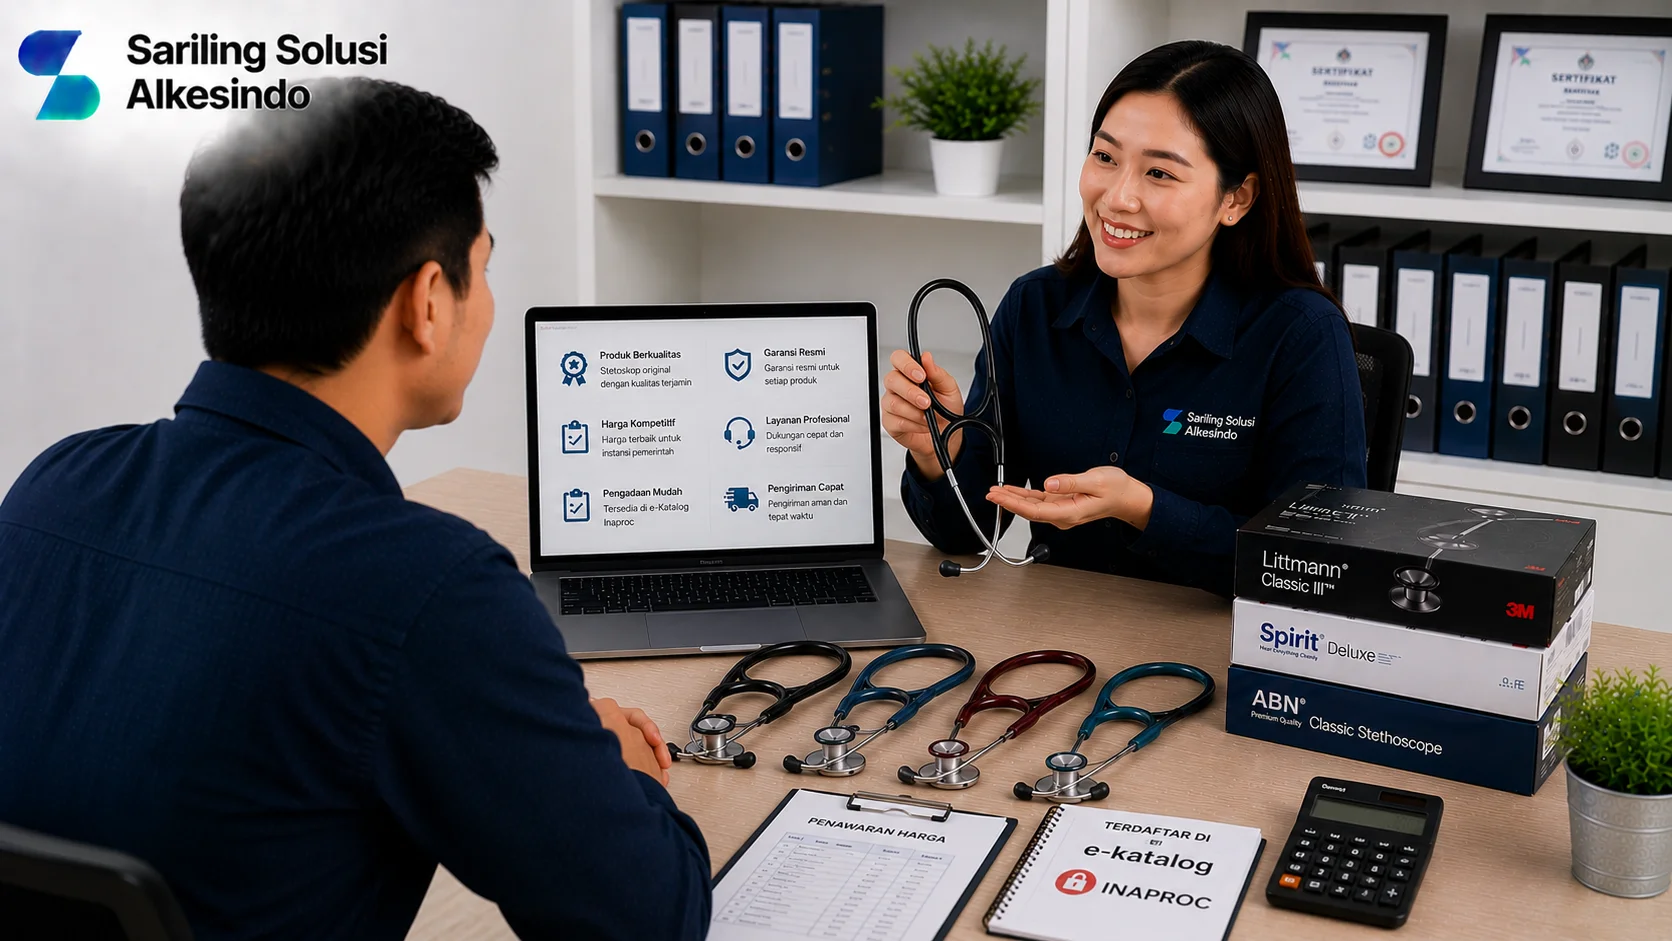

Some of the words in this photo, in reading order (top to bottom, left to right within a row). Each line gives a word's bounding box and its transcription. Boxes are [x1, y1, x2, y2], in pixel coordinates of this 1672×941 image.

[1551, 73, 1616, 84] SERTIFIKAT
[600, 351, 631, 359] Produk
[633, 350, 681, 359] Berkualitas
[764, 348, 797, 356] Garansi
[799, 348, 826, 356] Resmi
[600, 366, 641, 375] Stetoskop
[642, 366, 671, 375] original
[764, 363, 794, 371] Garansi
[795, 363, 817, 371] resmi
[818, 363, 840, 371] untuk
[600, 380, 629, 389] dengan
[661, 378, 692, 388] terjamin
[765, 377, 788, 385] setiap
[790, 376, 817, 385] produk
[601, 420, 628, 430] Harga
[766, 416, 801, 426] Layanan
[803, 415, 850, 423] Profesional
[1187, 412, 1223, 427] Sariling
[1225, 415, 1256, 427] Solusi
[766, 431, 805, 441] Dukungan
[829, 430, 844, 438] dan
[1184, 426, 1238, 440] Alkesindo
[602, 436, 627, 445] Harga
[628, 435, 656, 443] terbaik
[658, 434, 681, 442] untuk
[602, 449, 631, 457] instansi
[632, 447, 675, 457] pemerintah
[766, 444, 802, 454] responsif
[603, 489, 651, 499] Pengadaan
[652, 488, 683, 496] Mudah
[768, 484, 817, 494] Pengiriman
[603, 505, 638, 513] Tersedia
[640, 504, 648, 512] di
[649, 503, 690, 512] e-Katalog
[768, 500, 810, 509] Pengiriman
[768, 513, 789, 522] tepat
[790, 512, 814, 520] waktu
[603, 518, 635, 528] Inaproc
[1261, 572, 1310, 593] Classic
[1505, 601, 1535, 620] 3M
[1327, 641, 1376, 663] Deluxe
[1309, 716, 1355, 737] Classic
[1357, 725, 1443, 755] Stethoscope
[807, 817, 896, 836] PENAWARAN
[897, 830, 946, 843] HARGA
[1104, 821, 1192, 840] TERDAFTAR
[1194, 833, 1212, 843] DI
[1083, 845, 1214, 876] e-katalog
[1101, 882, 1212, 910] INAPROC
